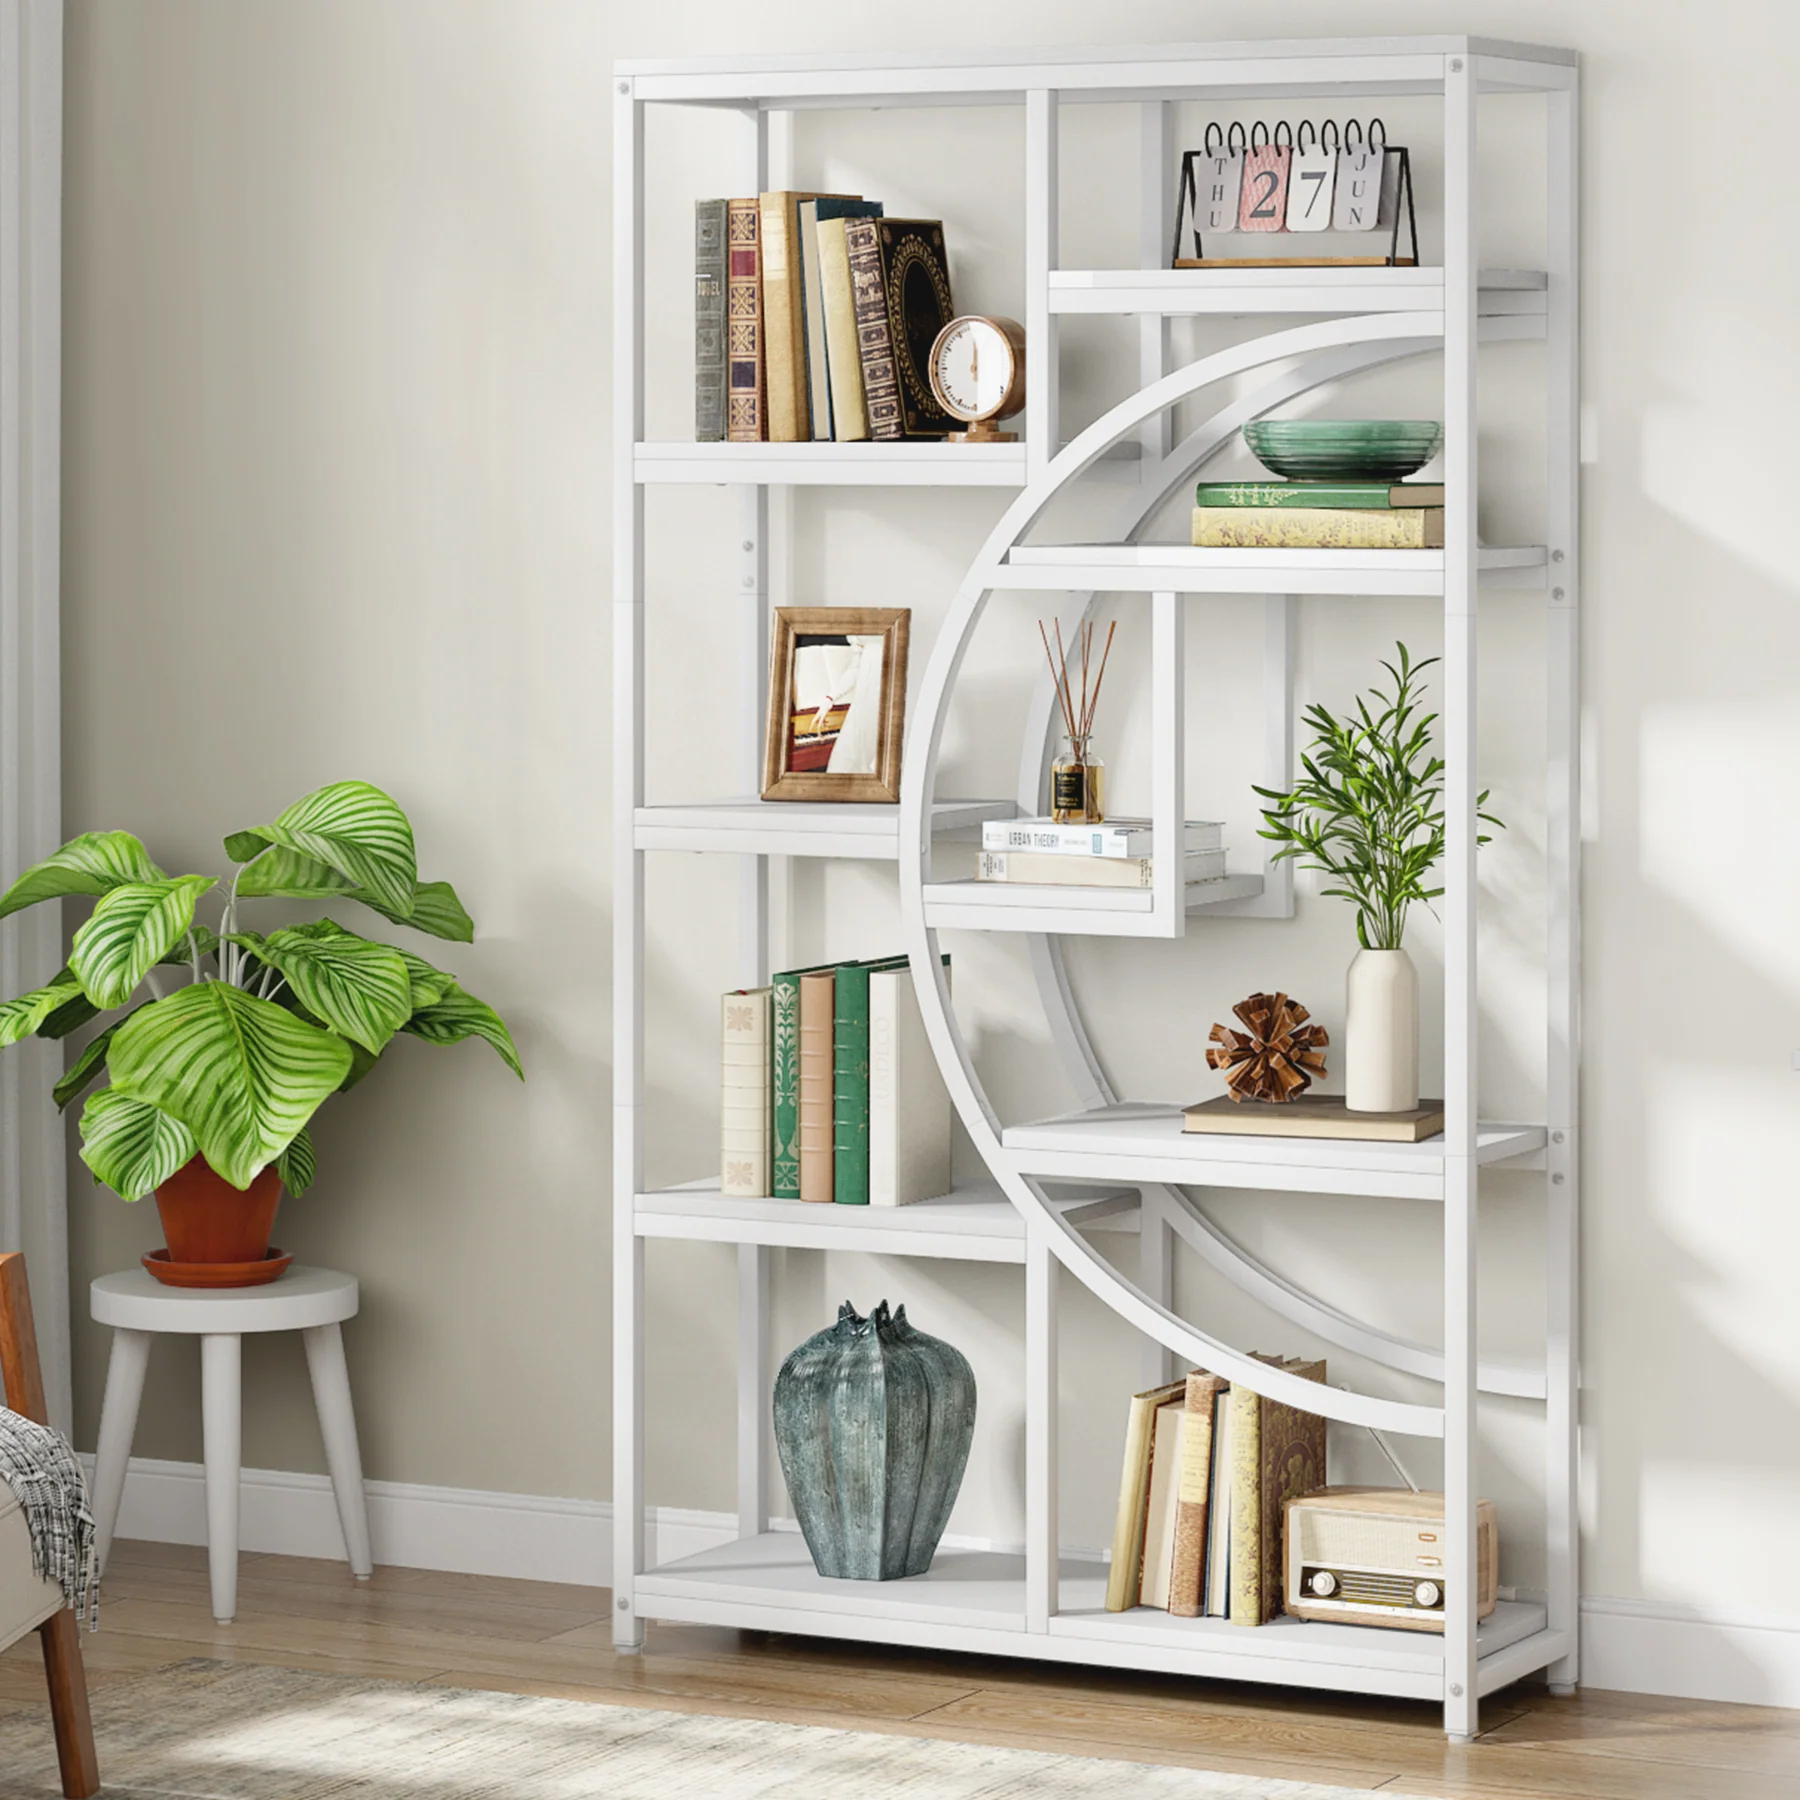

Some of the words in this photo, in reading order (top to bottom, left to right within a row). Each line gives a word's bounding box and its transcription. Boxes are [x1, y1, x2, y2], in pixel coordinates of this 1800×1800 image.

[1209, 157, 1228, 228] THU
[1249, 170, 1279, 218] 2
[1300, 171, 1327, 218] 7
[1349, 153, 1367, 225] JUN
[1008, 831, 1032, 846] URBAN
[1033, 833, 1060, 848] THEORY
